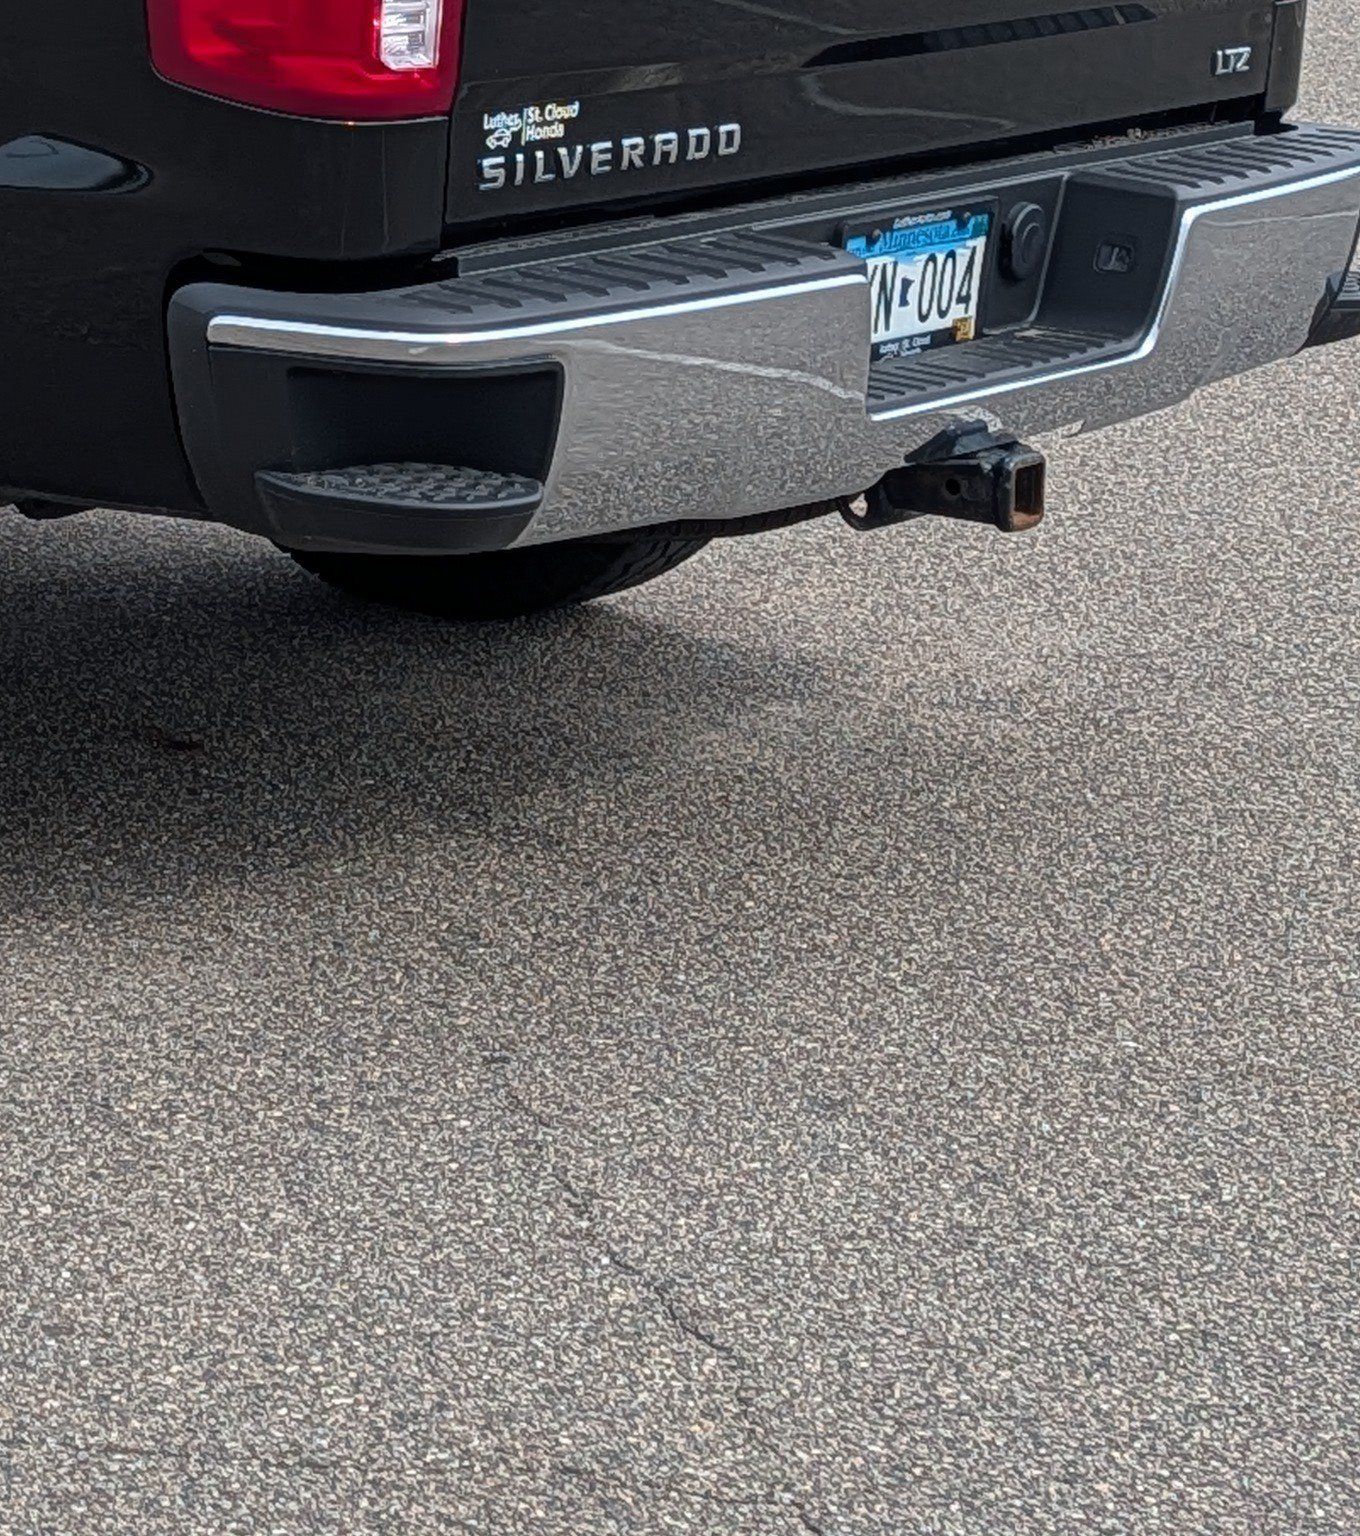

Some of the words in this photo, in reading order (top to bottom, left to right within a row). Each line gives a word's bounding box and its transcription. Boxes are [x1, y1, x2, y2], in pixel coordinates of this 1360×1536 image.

[1215, 46, 1252, 75] LTZ
[544, 101, 579, 121] Cloud
[526, 122, 565, 141] Honda
[480, 123, 741, 190] SILVERADO
[918, 246, 978, 324] 004
